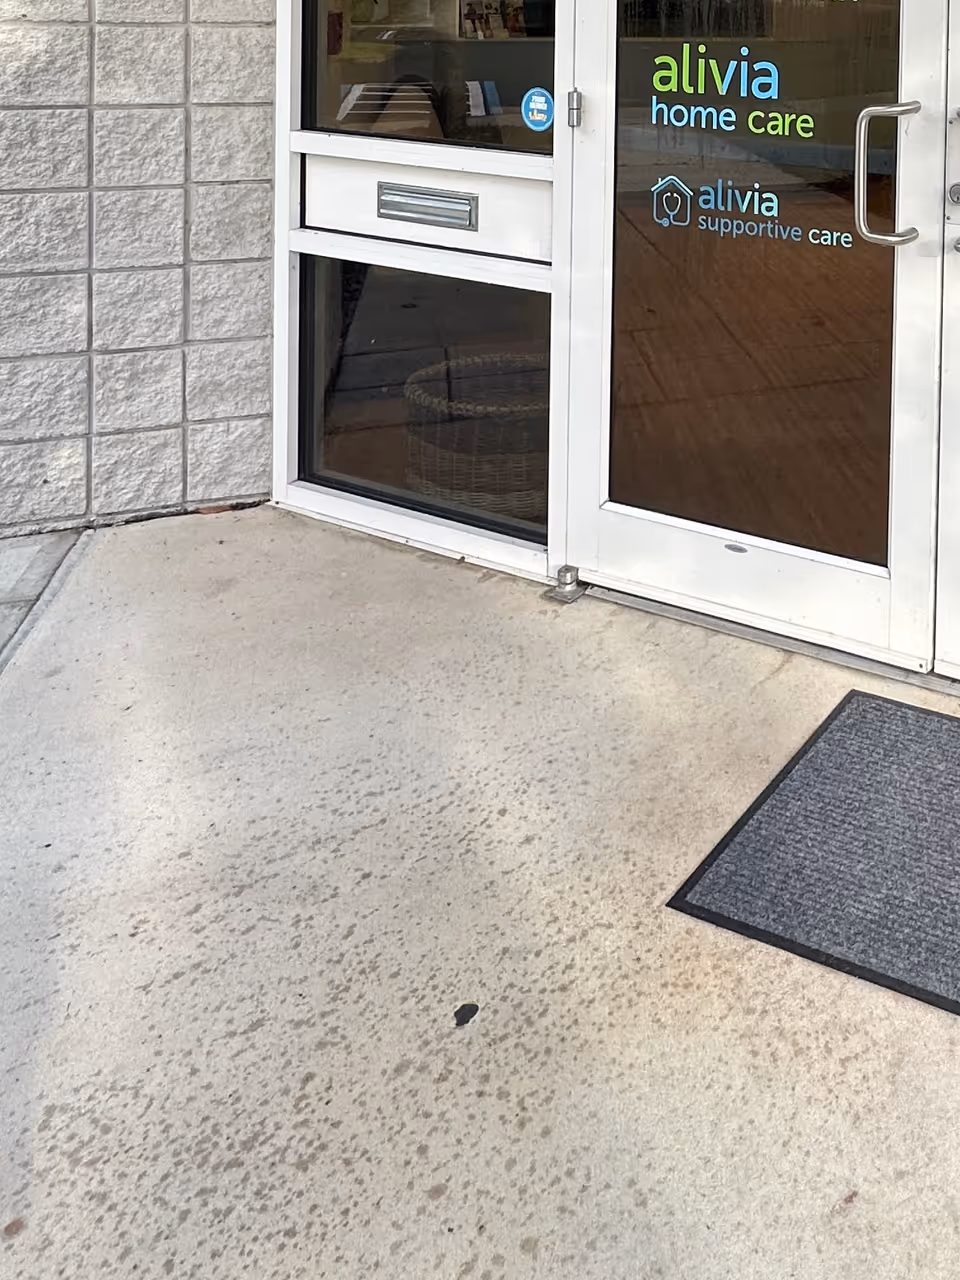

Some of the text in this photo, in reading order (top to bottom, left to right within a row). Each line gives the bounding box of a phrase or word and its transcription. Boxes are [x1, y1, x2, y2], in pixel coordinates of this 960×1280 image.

[652, 43, 779, 99] alivia
[651, 95, 815, 138] home care
[699, 179, 779, 217] alivia
[698, 215, 853, 248] supportive care
